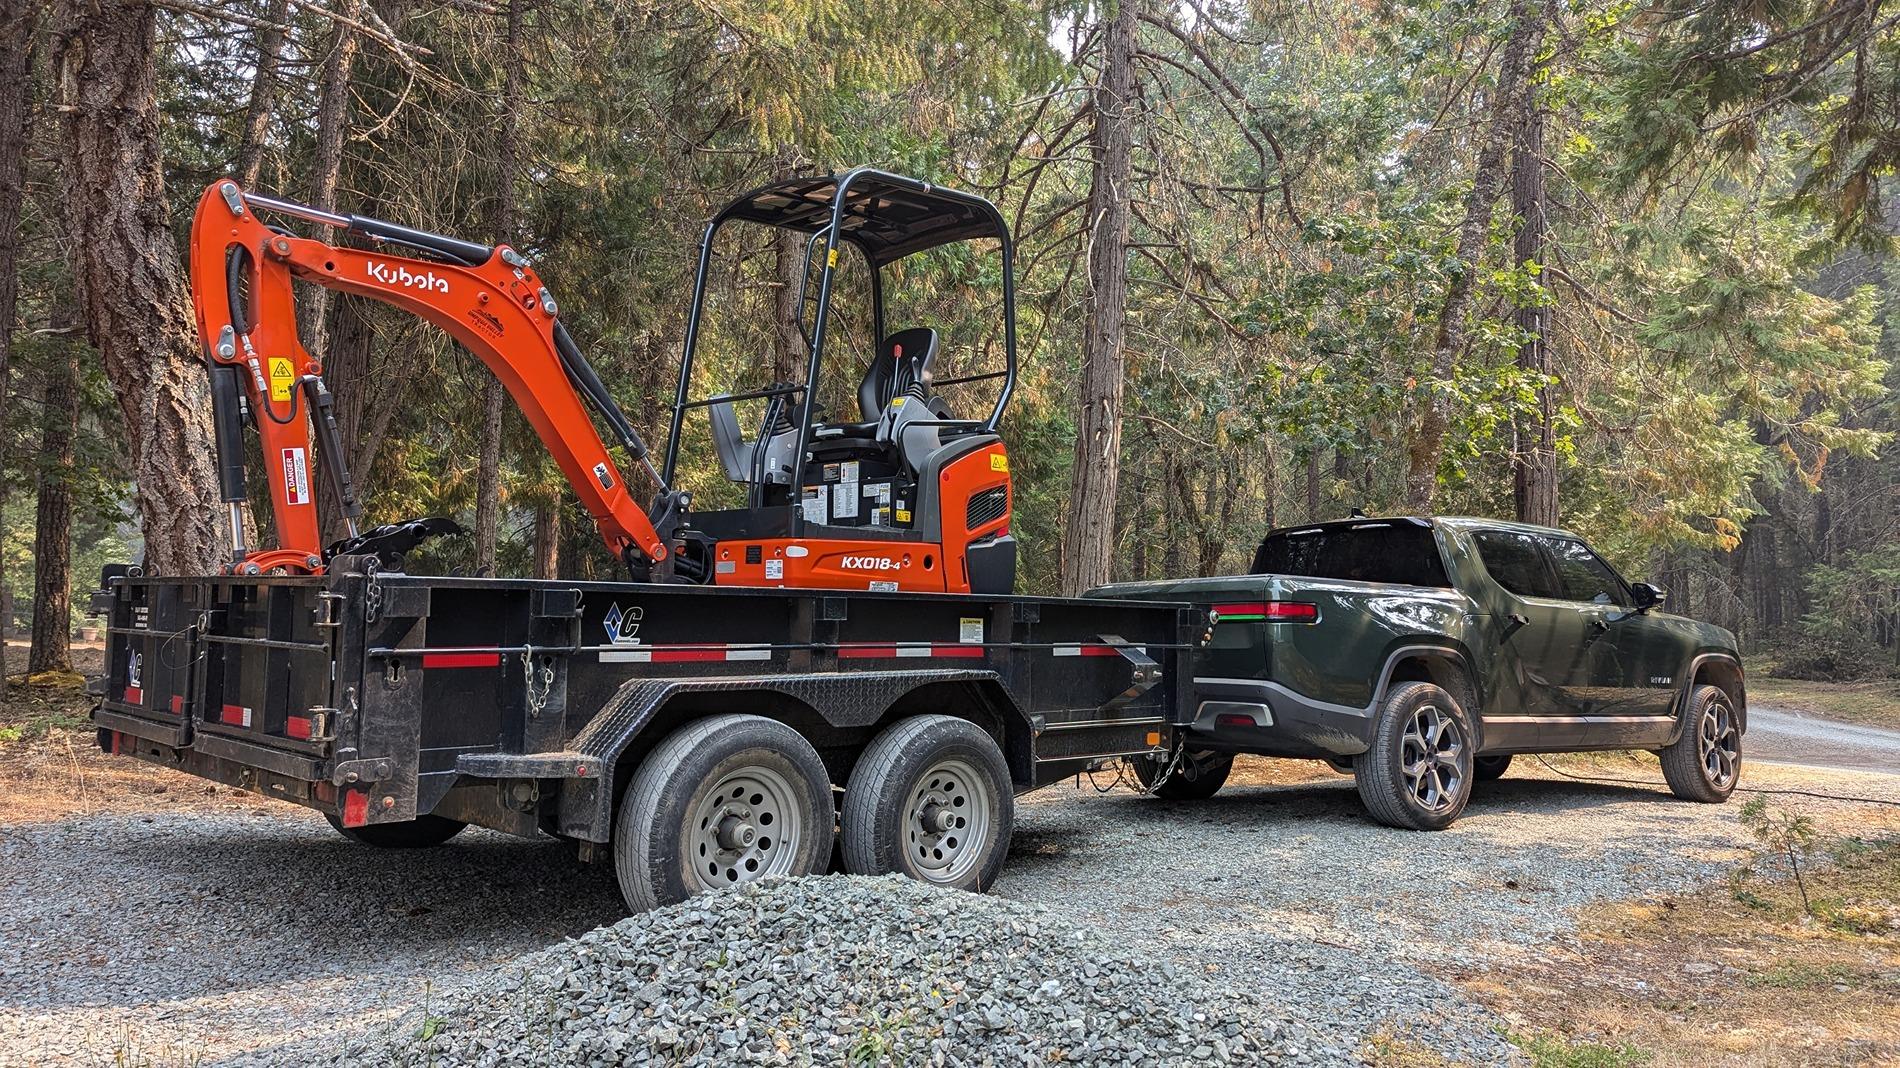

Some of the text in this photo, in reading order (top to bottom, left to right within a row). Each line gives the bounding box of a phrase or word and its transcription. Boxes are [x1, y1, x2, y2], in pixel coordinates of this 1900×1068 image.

[367, 261, 449, 293] Kubota
[286, 458, 296, 487] DANGER
[841, 556, 900, 570] KX018-4
